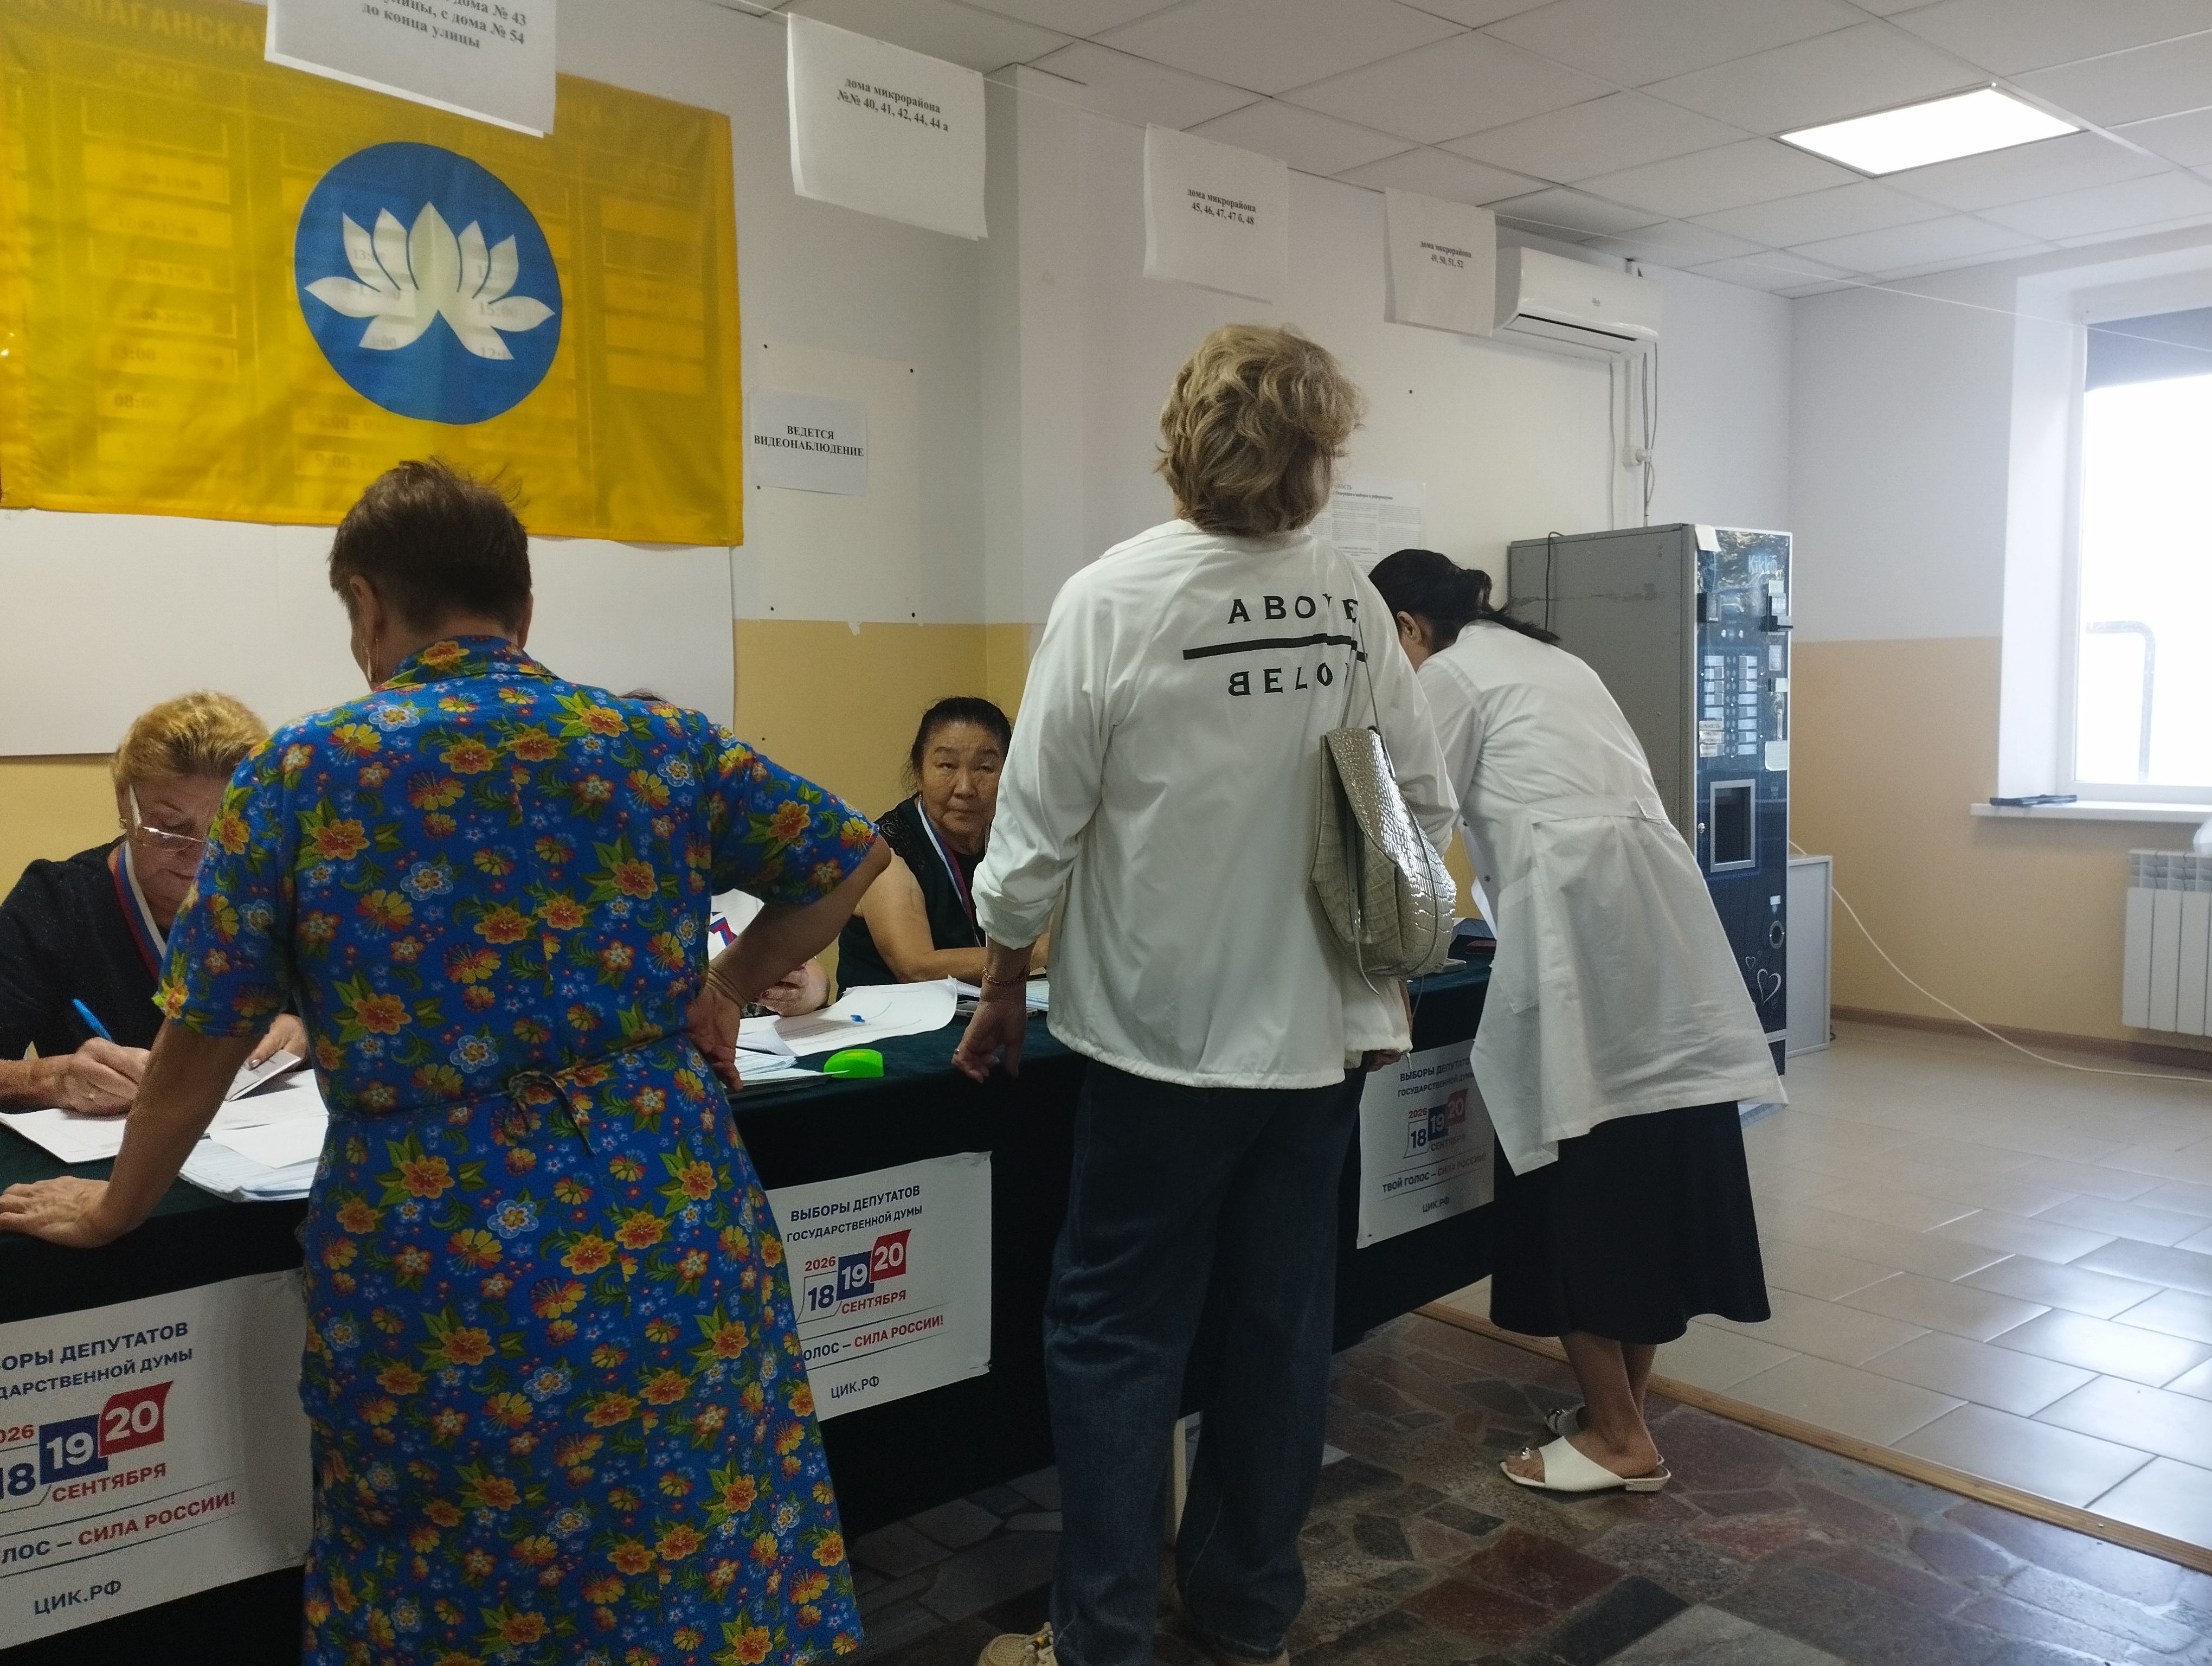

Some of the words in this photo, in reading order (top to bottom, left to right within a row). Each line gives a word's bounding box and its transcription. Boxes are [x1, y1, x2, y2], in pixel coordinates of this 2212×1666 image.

[362, 3, 380, 16] до
[384, 10, 428, 33] конца
[432, 25, 480, 48] улицы
[441, 10, 448, 20] с
[452, 12, 486, 31] дома
[491, 22, 506, 39] №
[510, 29, 524, 44] 54
[492, 4, 508, 20] №
[511, 12, 526, 26] 43
[845, 79, 871, 92] дома
[874, 87, 941, 113] микрорайона
[837, 89, 861, 107] №№
[864, 98, 878, 113] 40,
[880, 102, 895, 117] 41,
[897, 108, 911, 121] 42,
[914, 113, 928, 127] 44,
[930, 118, 940, 129] 44
[943, 124, 948, 132] а
[1187, 189, 1205, 199] дома
[1207, 194, 1256, 213] микрорайона
[1192, 202, 1203, 213] 45,
[1204, 205, 1214, 216] 46,
[1216, 209, 1226, 219] 47,
[1228, 212, 1236, 220] 47
[1246, 216, 1255, 225] 48
[1420, 241, 1434, 249] дома
[1435, 245, 1471, 258] микрорайона
[1457, 260, 1463, 268] 52
[787, 425, 834, 440] ВЕДЕТСЯ
[754, 435, 864, 457] ВИДЕОНАБЛЮДЕНИЕ
[1228, 662, 1348, 696] BELO
[1400, 1067, 1435, 1082] ВЫБОРЫ
[1436, 1057, 1470, 1075] ДЕПУТАТО
[1398, 1074, 1457, 1097] ГОСУДАРСТВЕННОЙ
[1409, 1108, 1427, 1119] 2026
[1411, 1129, 1427, 1149] 18
[1430, 1113, 1445, 1133] 19
[1448, 1098, 1464, 1119] 20
[1382, 1178, 1403, 1193] ТВОЙ
[1404, 1172, 1430, 1186] ГОЛОС
[790, 1202, 850, 1221] ВЫБОРЫ
[853, 1185, 920, 1213] ДЕПУТАТОВ
[1423, 1196, 1449, 1213] ЦИК.РФ
[787, 1211, 891, 1242] ГОСУДАРСТВЕННОЙ
[893, 1205, 922, 1222] ДУМЫ
[805, 1256, 836, 1272] 2026
[808, 1284, 834, 1311] 18
[841, 1263, 867, 1291] 19
[874, 1242, 904, 1272] 20
[841, 1290, 906, 1314] СЕНТЯБРЯ
[0, 1349, 54, 1370] ОРЫ
[60, 1322, 188, 1364] ДЕПУТАТОВ
[802, 1342, 839, 1361] ОЛОС
[854, 1330, 888, 1348] СИЛА
[891, 1315, 944, 1338] РОССИИ!
[140, 1348, 192, 1373] ДУМЫ
[831, 1376, 879, 1399] ЦИК.РФ
[47, 1432, 94, 1470] 19
[105, 1400, 159, 1441] 20
[52, 1463, 166, 1502] СЕНТЯБРЯ
[78, 1519, 138, 1546] СИЛА
[145, 1491, 235, 1529] РОССИИ!
[34, 1580, 122, 1616] ЦИК.РФ
